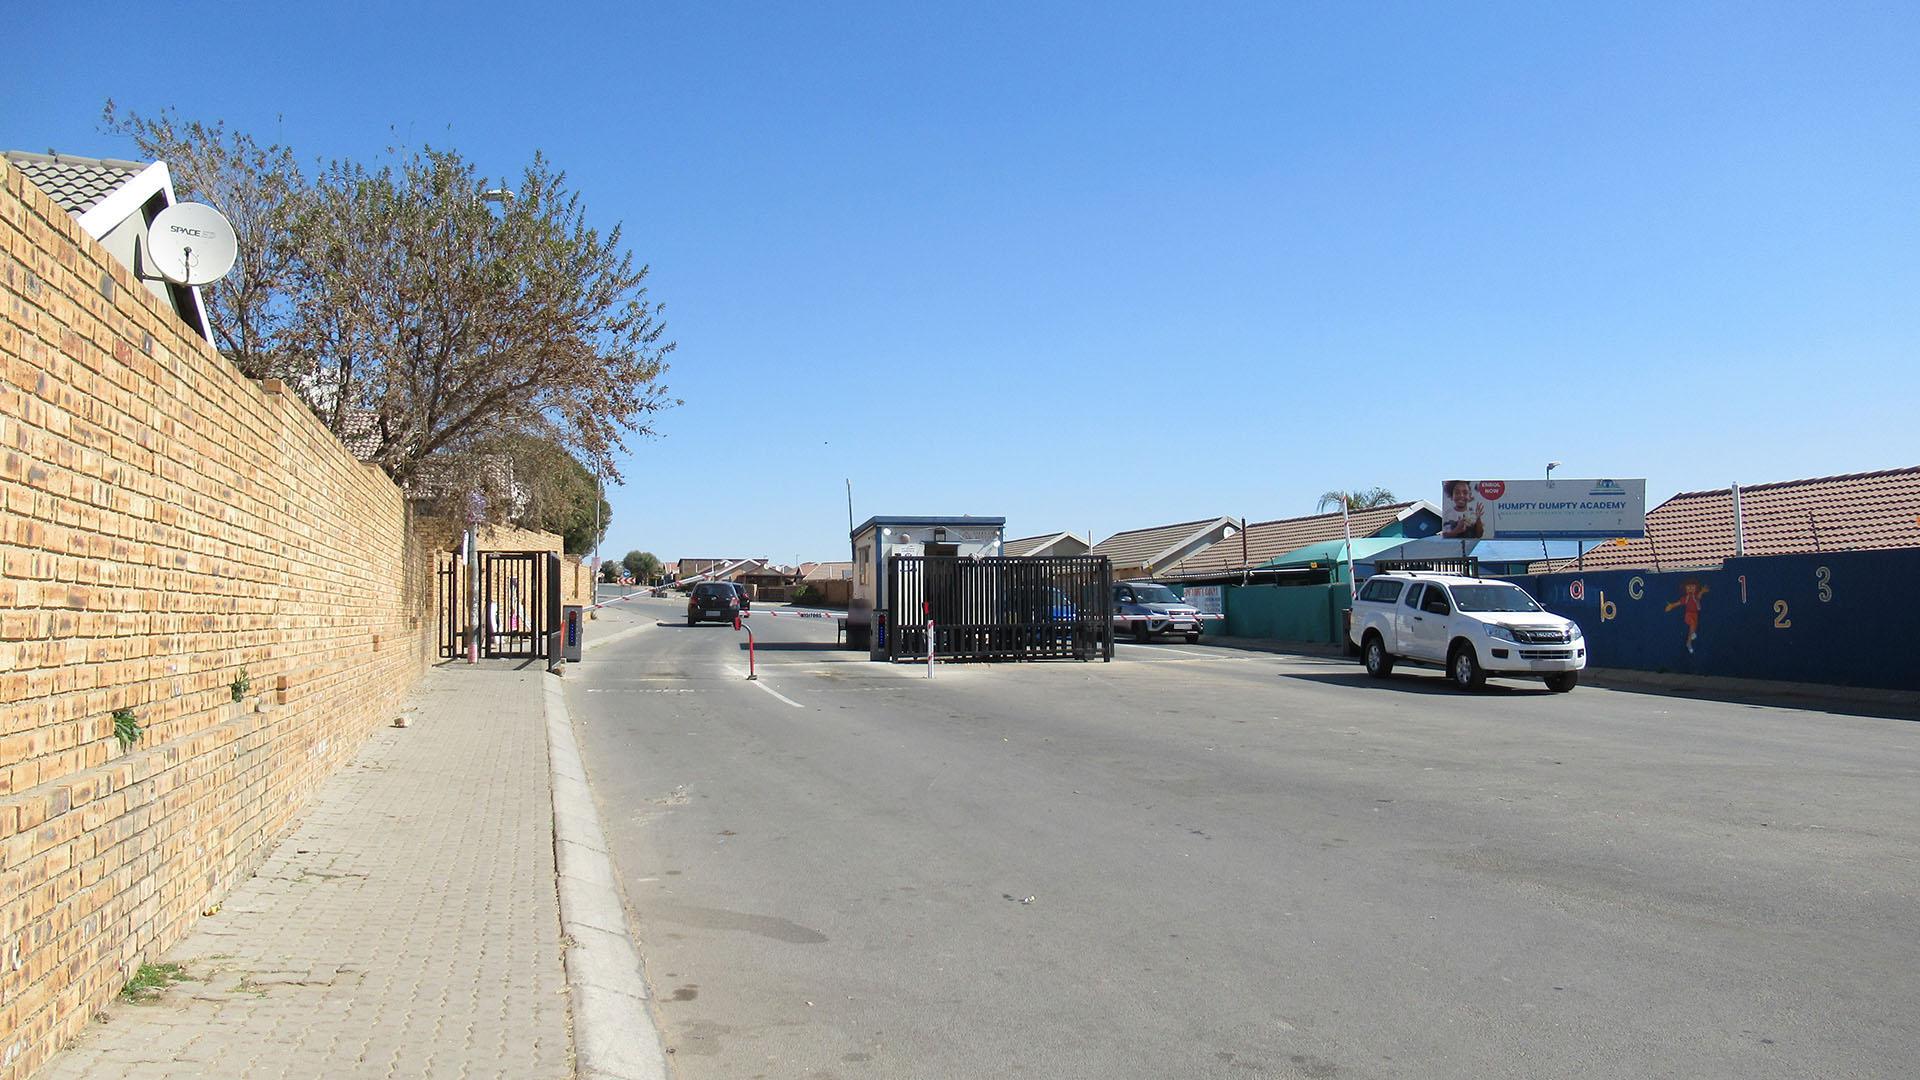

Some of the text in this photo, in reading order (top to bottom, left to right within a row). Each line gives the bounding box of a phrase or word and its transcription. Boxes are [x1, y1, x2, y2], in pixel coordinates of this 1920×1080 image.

[170, 225, 201, 238] SPACE
[1498, 501, 1626, 510] HUMPTY DUMPTY ACADEMY
[1569, 578, 1585, 600] a
[1600, 590, 1617, 622] b
[1738, 566, 1832, 628] 1 2 3
